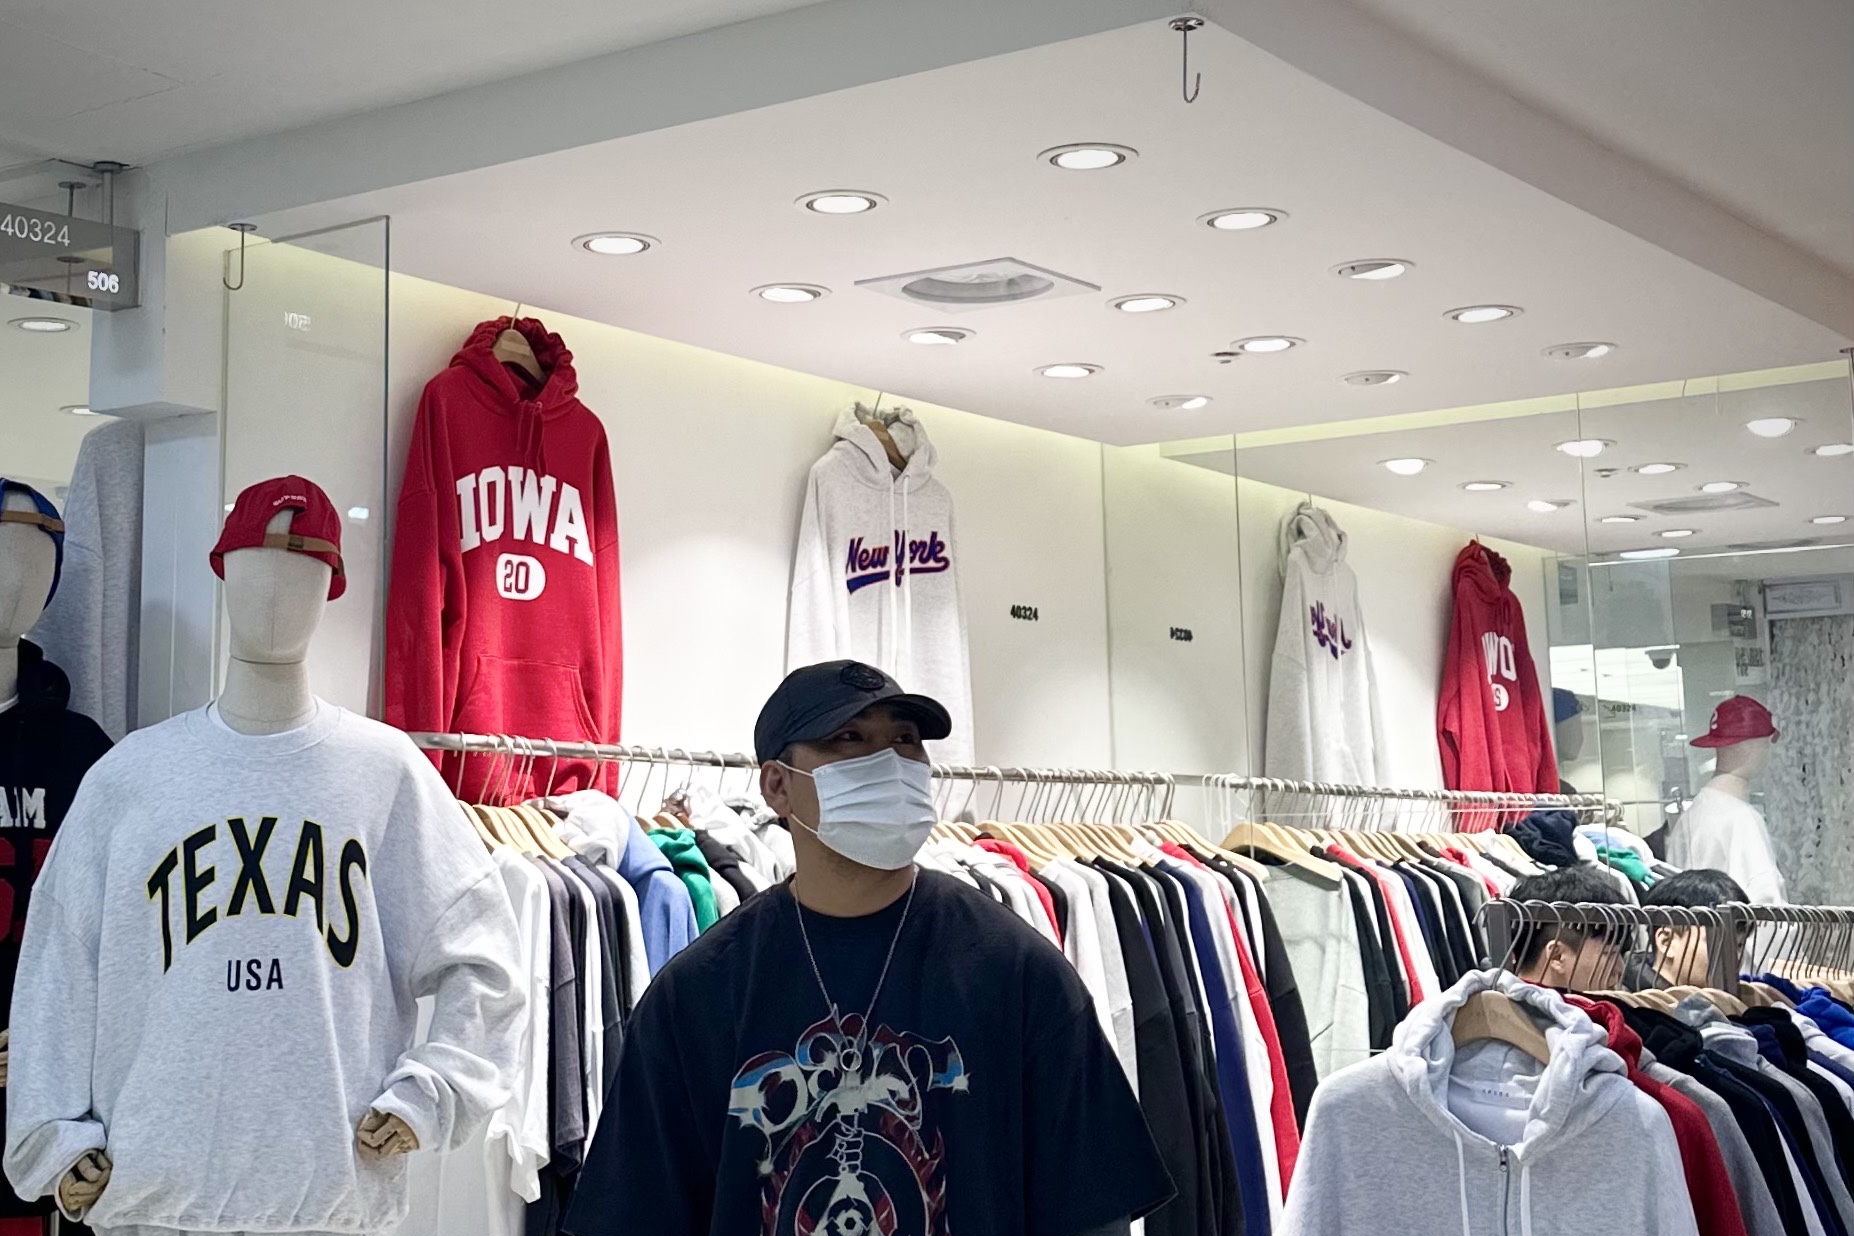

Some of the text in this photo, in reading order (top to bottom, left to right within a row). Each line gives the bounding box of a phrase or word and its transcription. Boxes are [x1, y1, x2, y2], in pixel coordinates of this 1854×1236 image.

[0, 213, 71, 247] 40324
[87, 270, 119, 294] 506
[456, 465, 594, 567] IOWA
[845, 529, 950, 588] New York
[503, 559, 530, 594] 20
[1010, 604, 1039, 622] 40324
[146, 816, 367, 976] TEXAS
[226, 958, 284, 992] USA
